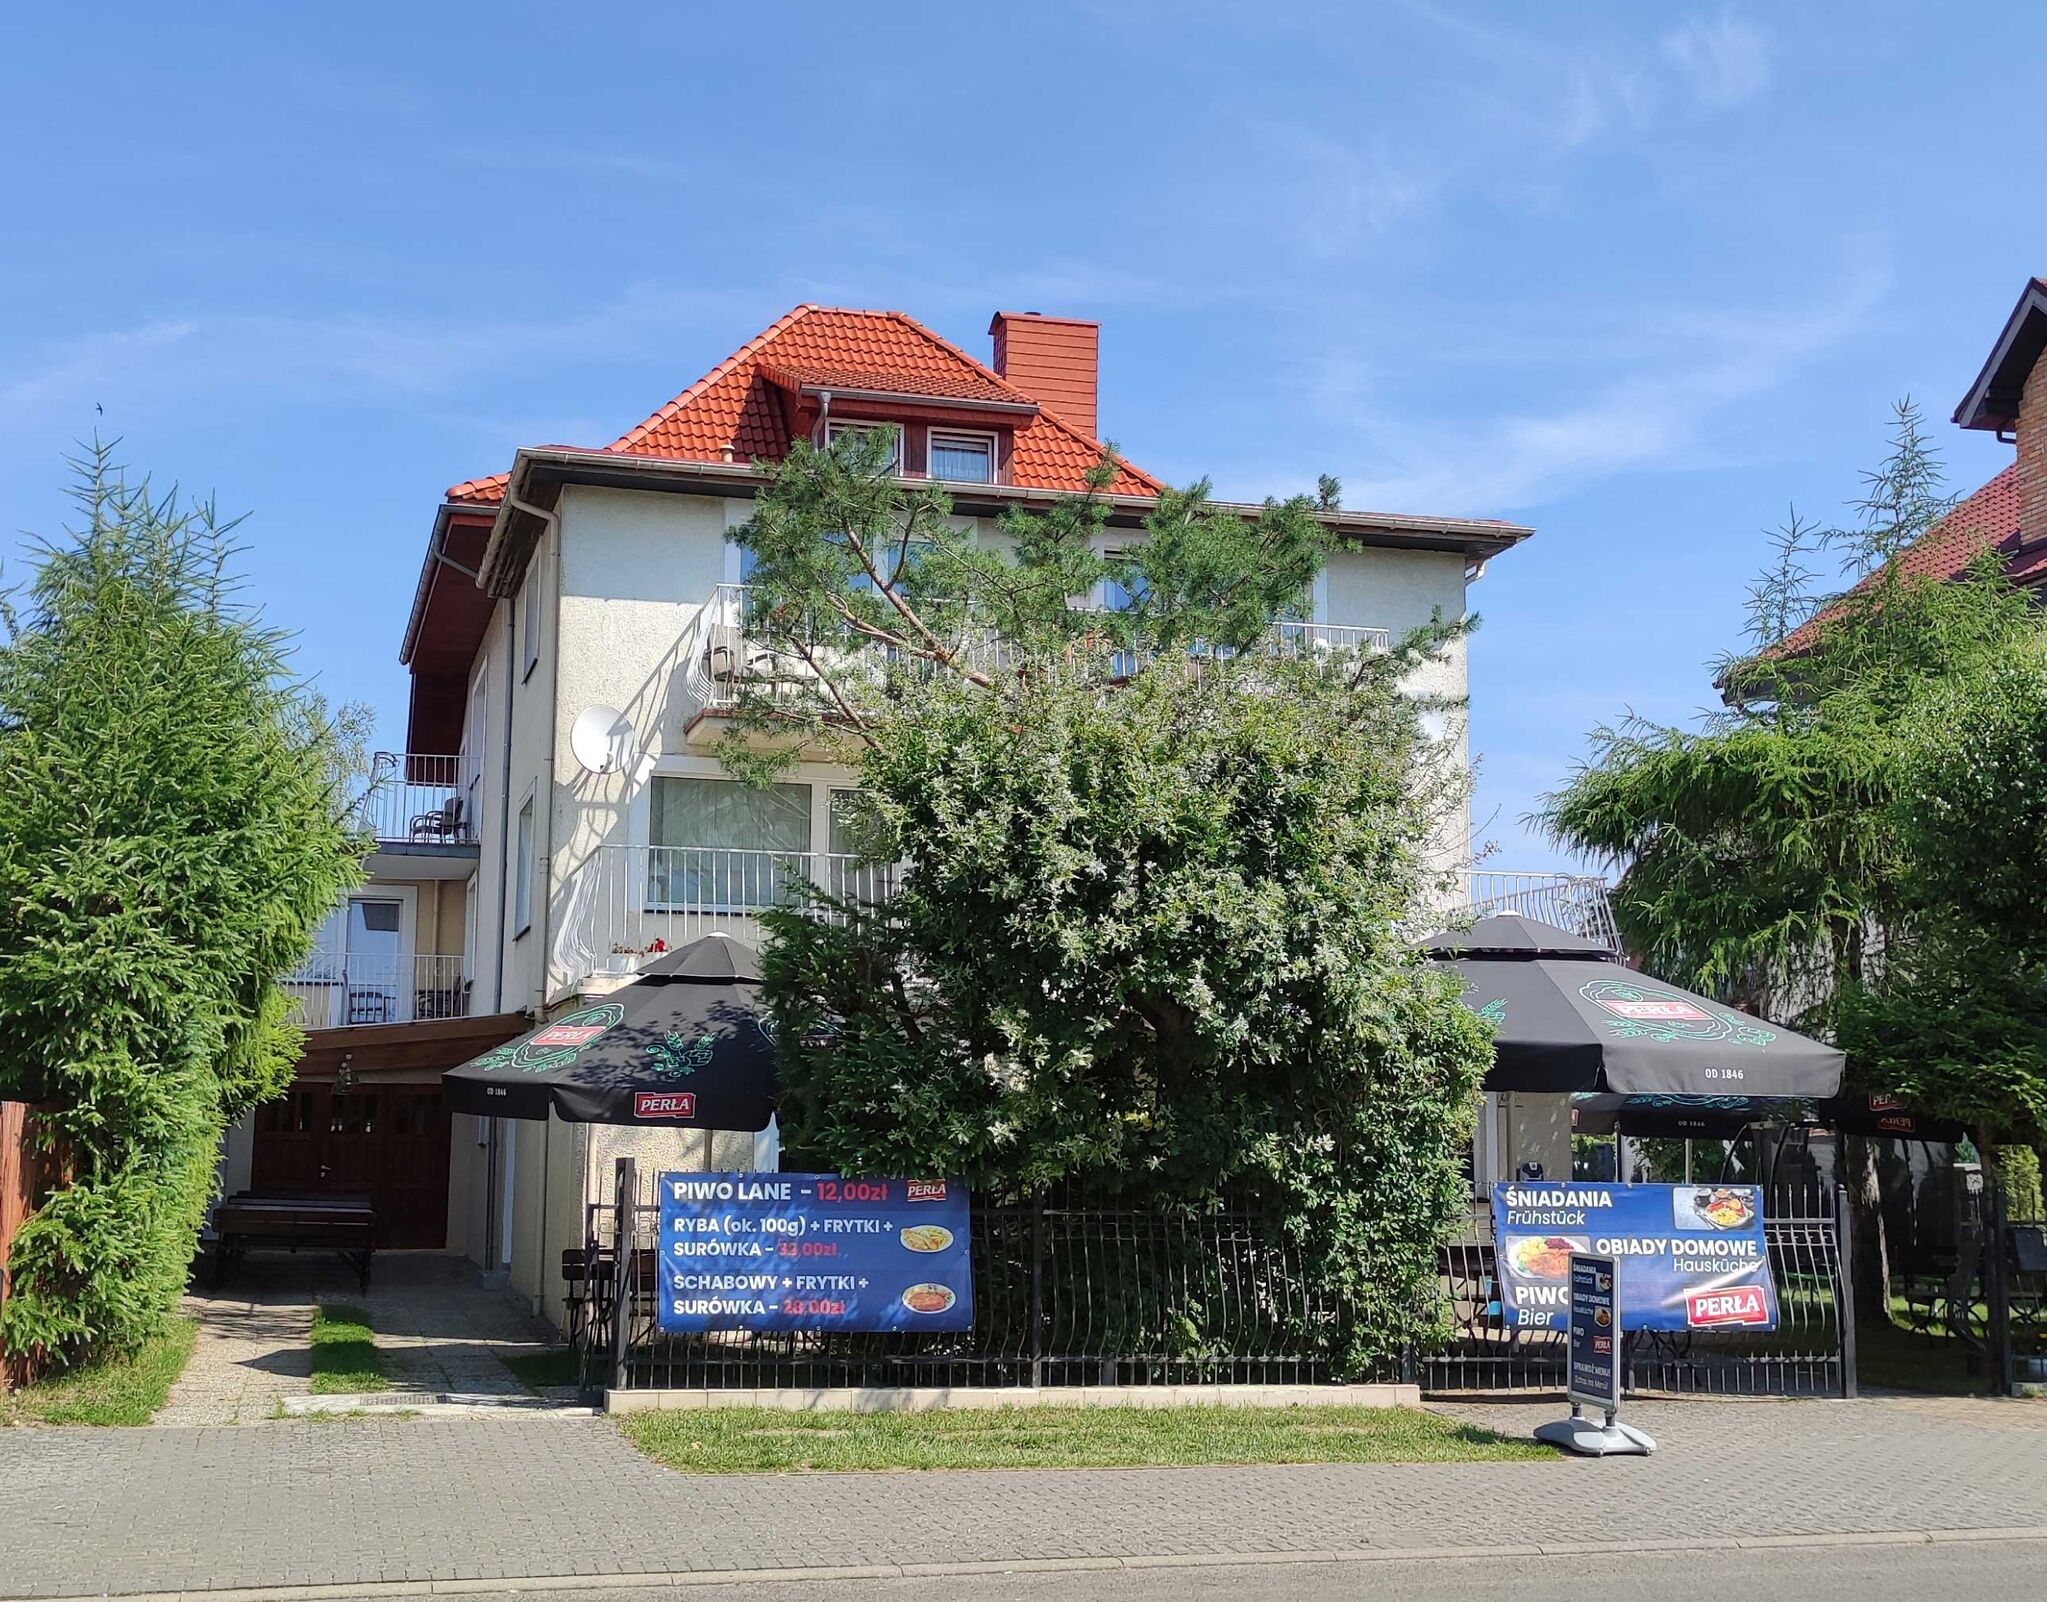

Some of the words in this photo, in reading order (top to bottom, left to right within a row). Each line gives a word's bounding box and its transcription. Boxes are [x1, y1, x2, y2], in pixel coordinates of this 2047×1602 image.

[1705, 1068, 1718, 1078] OD
[1721, 1069, 1744, 1080] 1846
[640, 1098, 689, 1112] PERŁA
[673, 1181, 733, 1200] PIWO
[738, 1182, 791, 1200] LANE
[817, 1182, 888, 1203] 12,00zł
[1505, 1185, 1613, 1208] ŚNIADANIA
[674, 1218, 720, 1233] RYBA
[723, 1214, 757, 1236] (ok.
[760, 1215, 806, 1237] 100g)
[823, 1219, 880, 1234] FRYTKI
[1507, 1210, 1586, 1225] Frühstück
[673, 1238, 763, 1257] SURÓWKA
[1596, 1238, 1668, 1255] OBIADY
[1671, 1240, 1758, 1257] DOMOWE
[1673, 1258, 1759, 1273] Hausküche
[673, 1274, 778, 1290] SCHABOWY
[796, 1275, 855, 1290] FRYTKI
[673, 1295, 767, 1315] SURÓWKA
[1695, 1294, 1761, 1317] PERŁA
[1517, 1308, 1554, 1326] Bier
